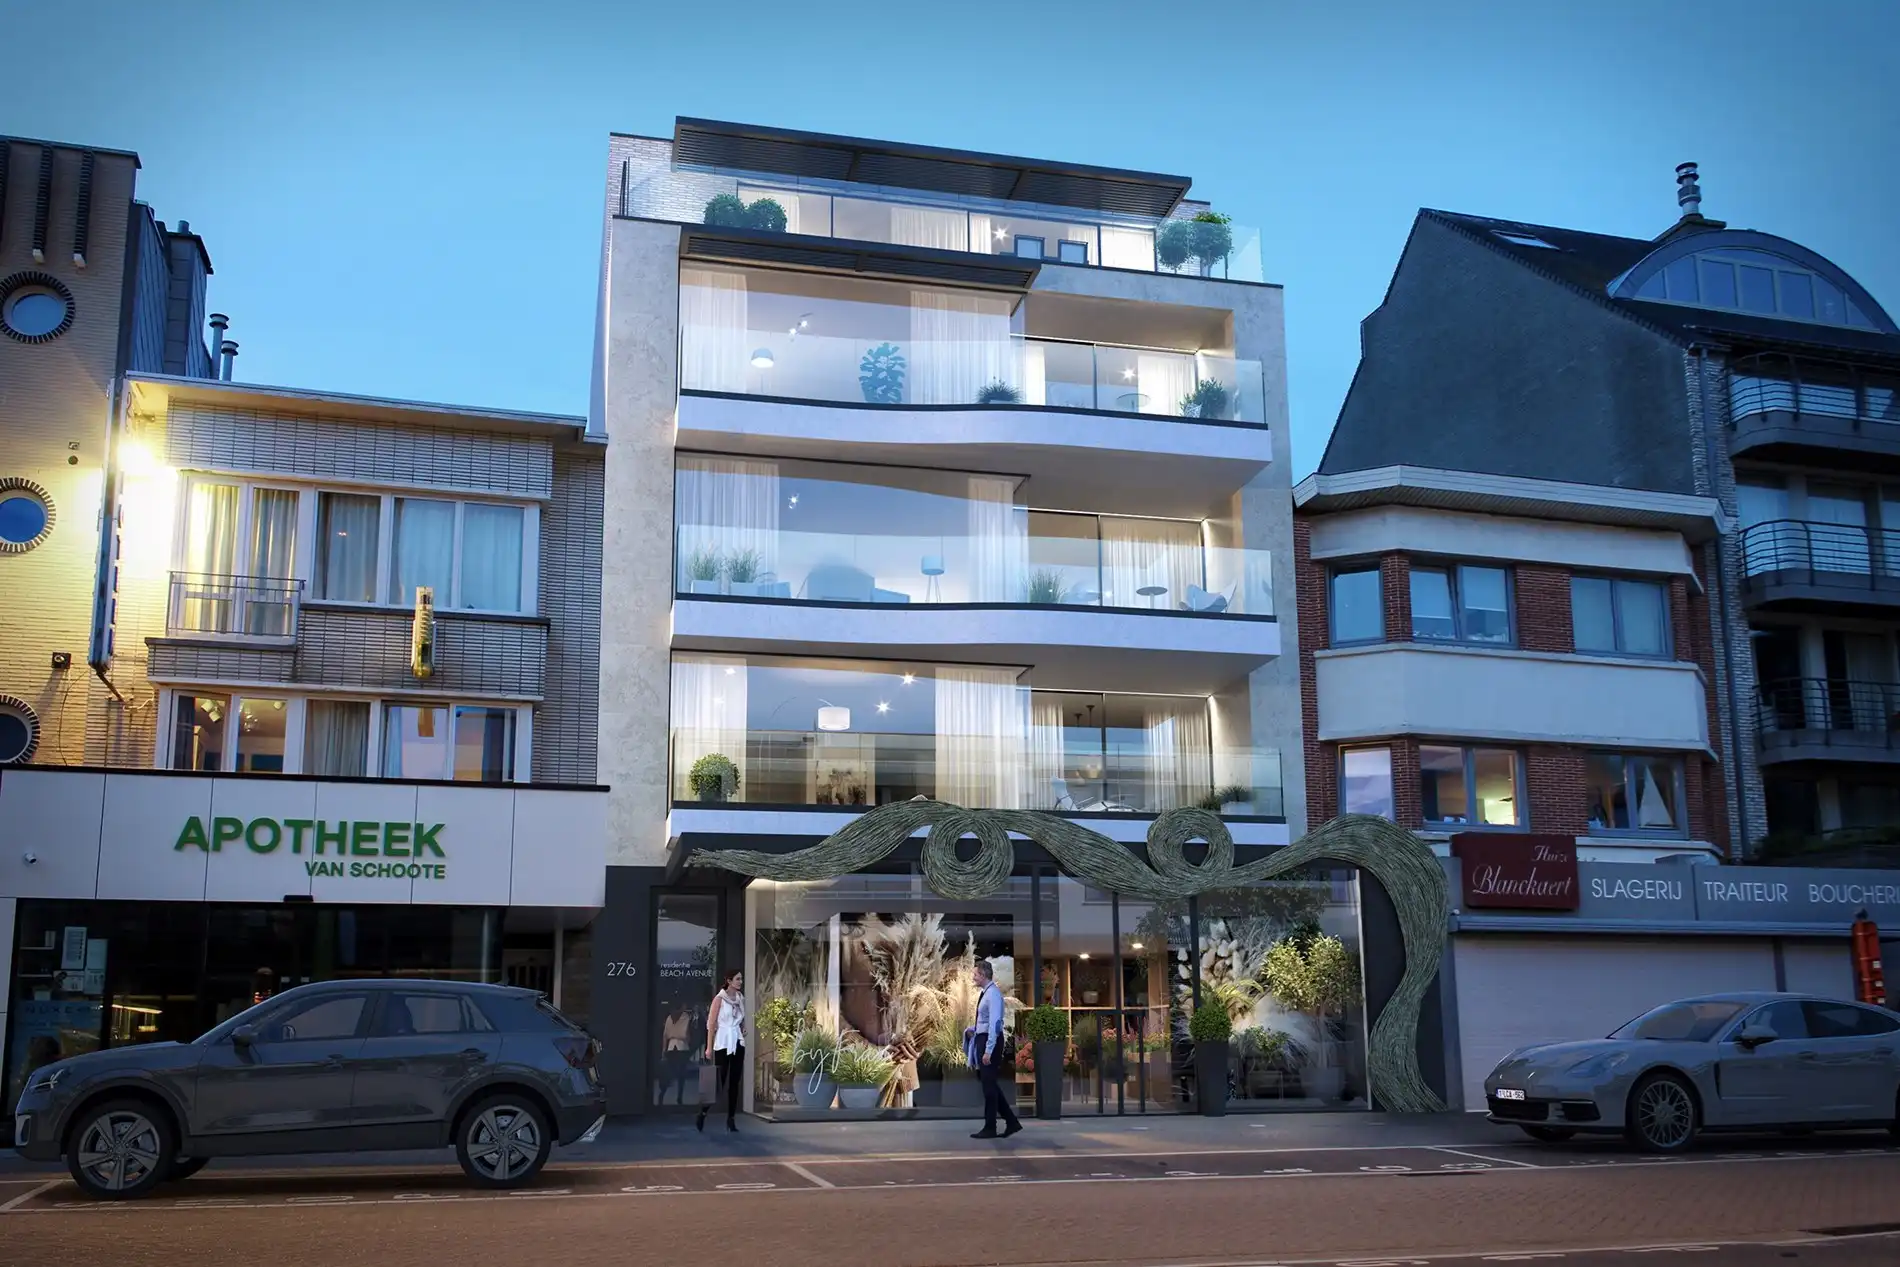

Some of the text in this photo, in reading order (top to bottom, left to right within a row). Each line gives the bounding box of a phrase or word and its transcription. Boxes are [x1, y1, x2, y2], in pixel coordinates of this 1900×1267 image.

[174, 815, 446, 858] APOTHEEK
[305, 861, 446, 880] VAN SCHOOTE
[1591, 878, 1682, 901] SLAGERIJ
[1703, 881, 1789, 903] TRAITEUR
[607, 962, 636, 977] 276
[660, 969, 713, 977] BEACH AVENUE
